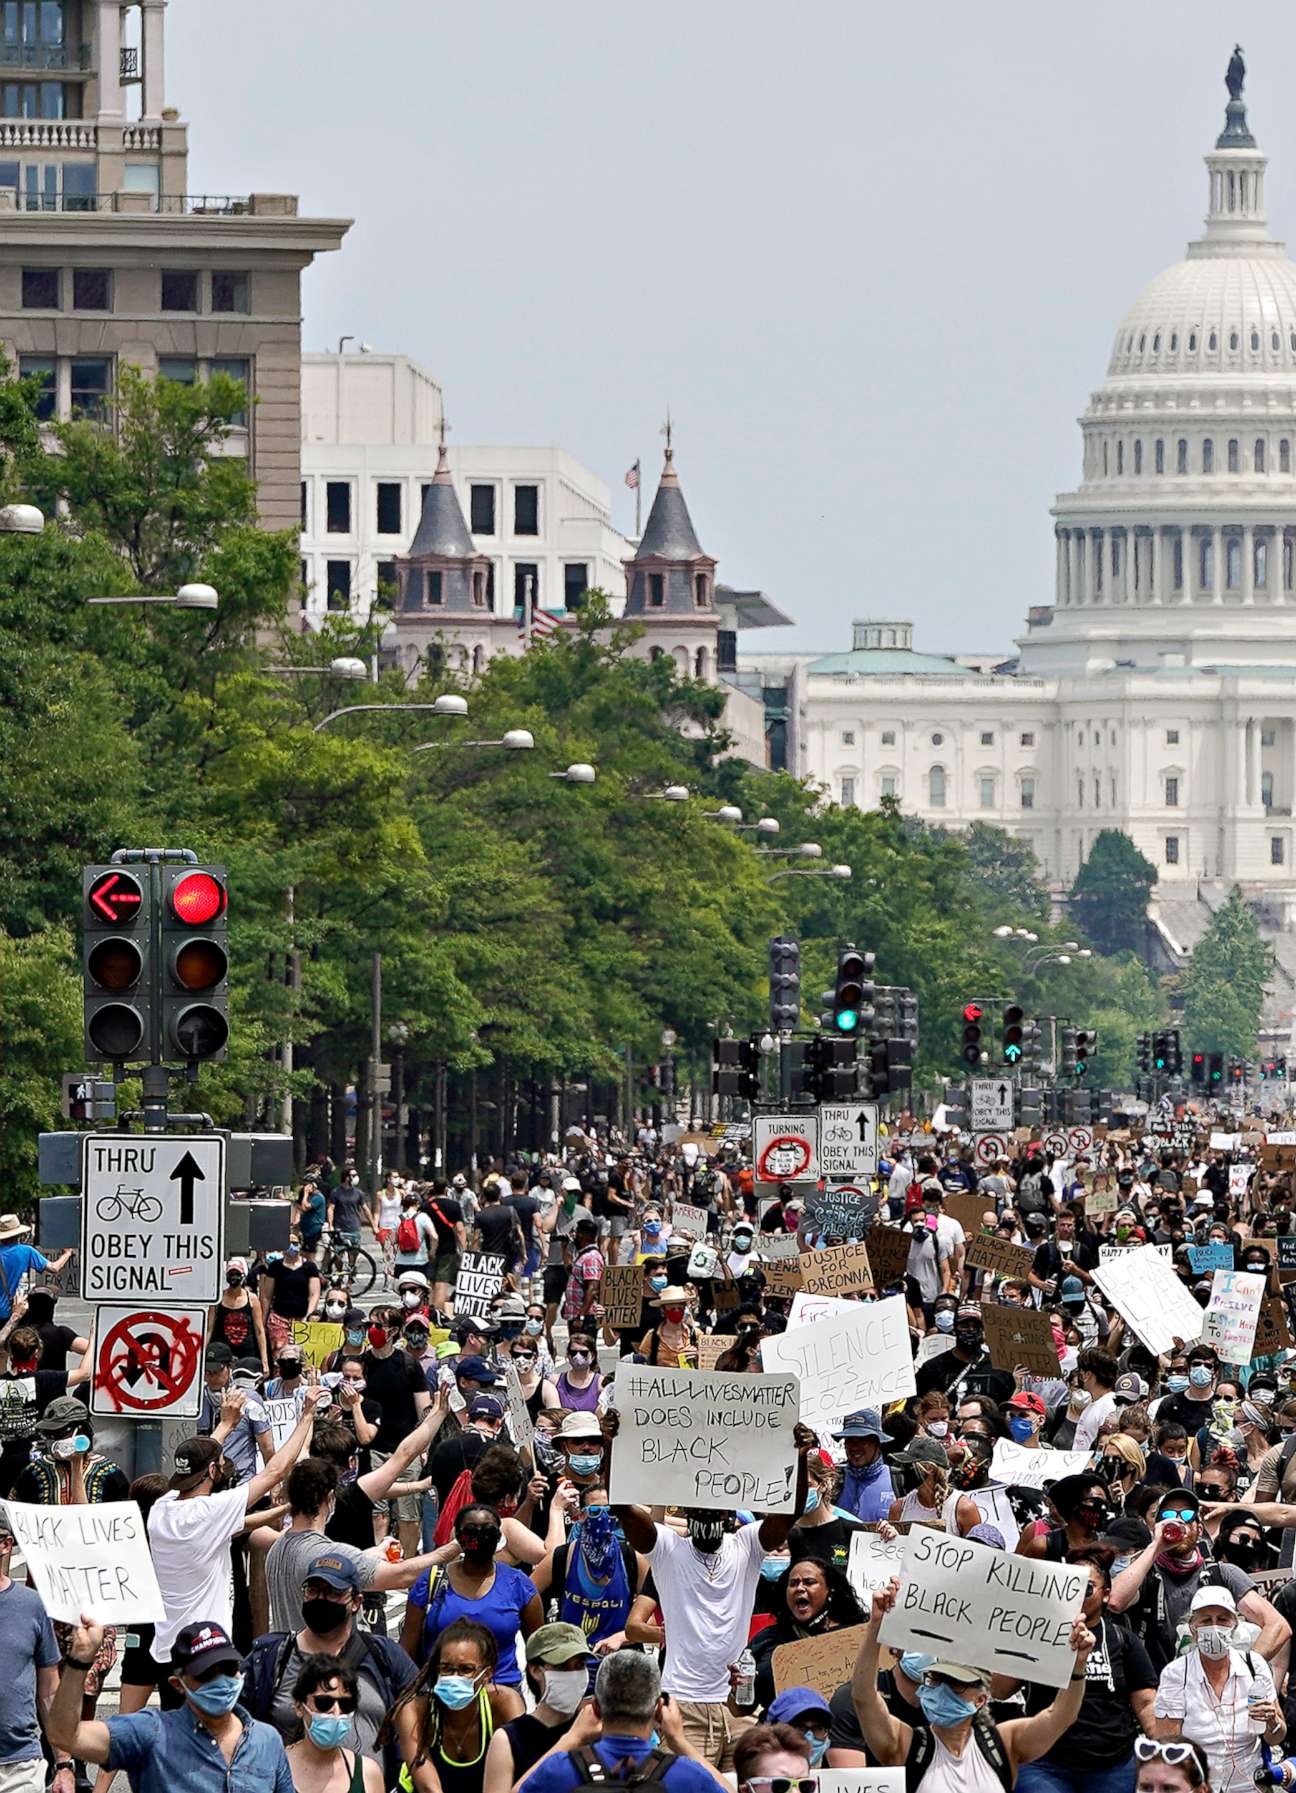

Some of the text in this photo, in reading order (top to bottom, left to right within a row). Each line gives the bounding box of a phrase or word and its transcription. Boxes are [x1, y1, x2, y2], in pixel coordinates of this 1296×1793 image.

[824, 1110, 849, 1121] THRU
[768, 1124, 805, 1135] TURNING
[94, 1148, 156, 1173] THRU
[823, 1147, 874, 1157] OBEY THIS
[823, 1160, 857, 1171] SIGNAL
[1231, 1178, 1246, 1188] NO
[824, 1191, 861, 1205] JUSTICE
[91, 1234, 214, 1259] OBEY THIS
[803, 1243, 865, 1270] JUSTICE
[975, 1238, 1036, 1263] BLACK LIVES
[461, 1251, 506, 1276] BLACK
[821, 1259, 849, 1275] FOR
[970, 1251, 1026, 1279] MATTER
[91, 1266, 172, 1290] SIGNAL
[458, 1270, 504, 1297] LIVES
[605, 1269, 640, 1288] BLACK
[807, 1265, 872, 1295] BREONNA
[1221, 1273, 1236, 1294] I
[455, 1293, 492, 1319] MATTE
[603, 1288, 639, 1307] LIVES
[1208, 1311, 1216, 1323] I
[1208, 1326, 1222, 1338] To
[777, 1316, 900, 1380] SILENCE
[818, 1364, 859, 1394] IS
[800, 1365, 912, 1419] IOLENCE
[634, 1405, 783, 1429] DOES INCLUDE
[641, 1436, 731, 1465] BLACK
[694, 1464, 794, 1507] PEOPLE!
[15, 1511, 137, 1552] BLACK LIVES
[688, 1518, 725, 1540] TRY ME
[854, 1536, 859, 1555] I
[913, 1536, 1081, 1602] STOP KILLING
[44, 1563, 139, 1607] MATTER
[903, 1582, 1073, 1647] BLACK PEOPLE
